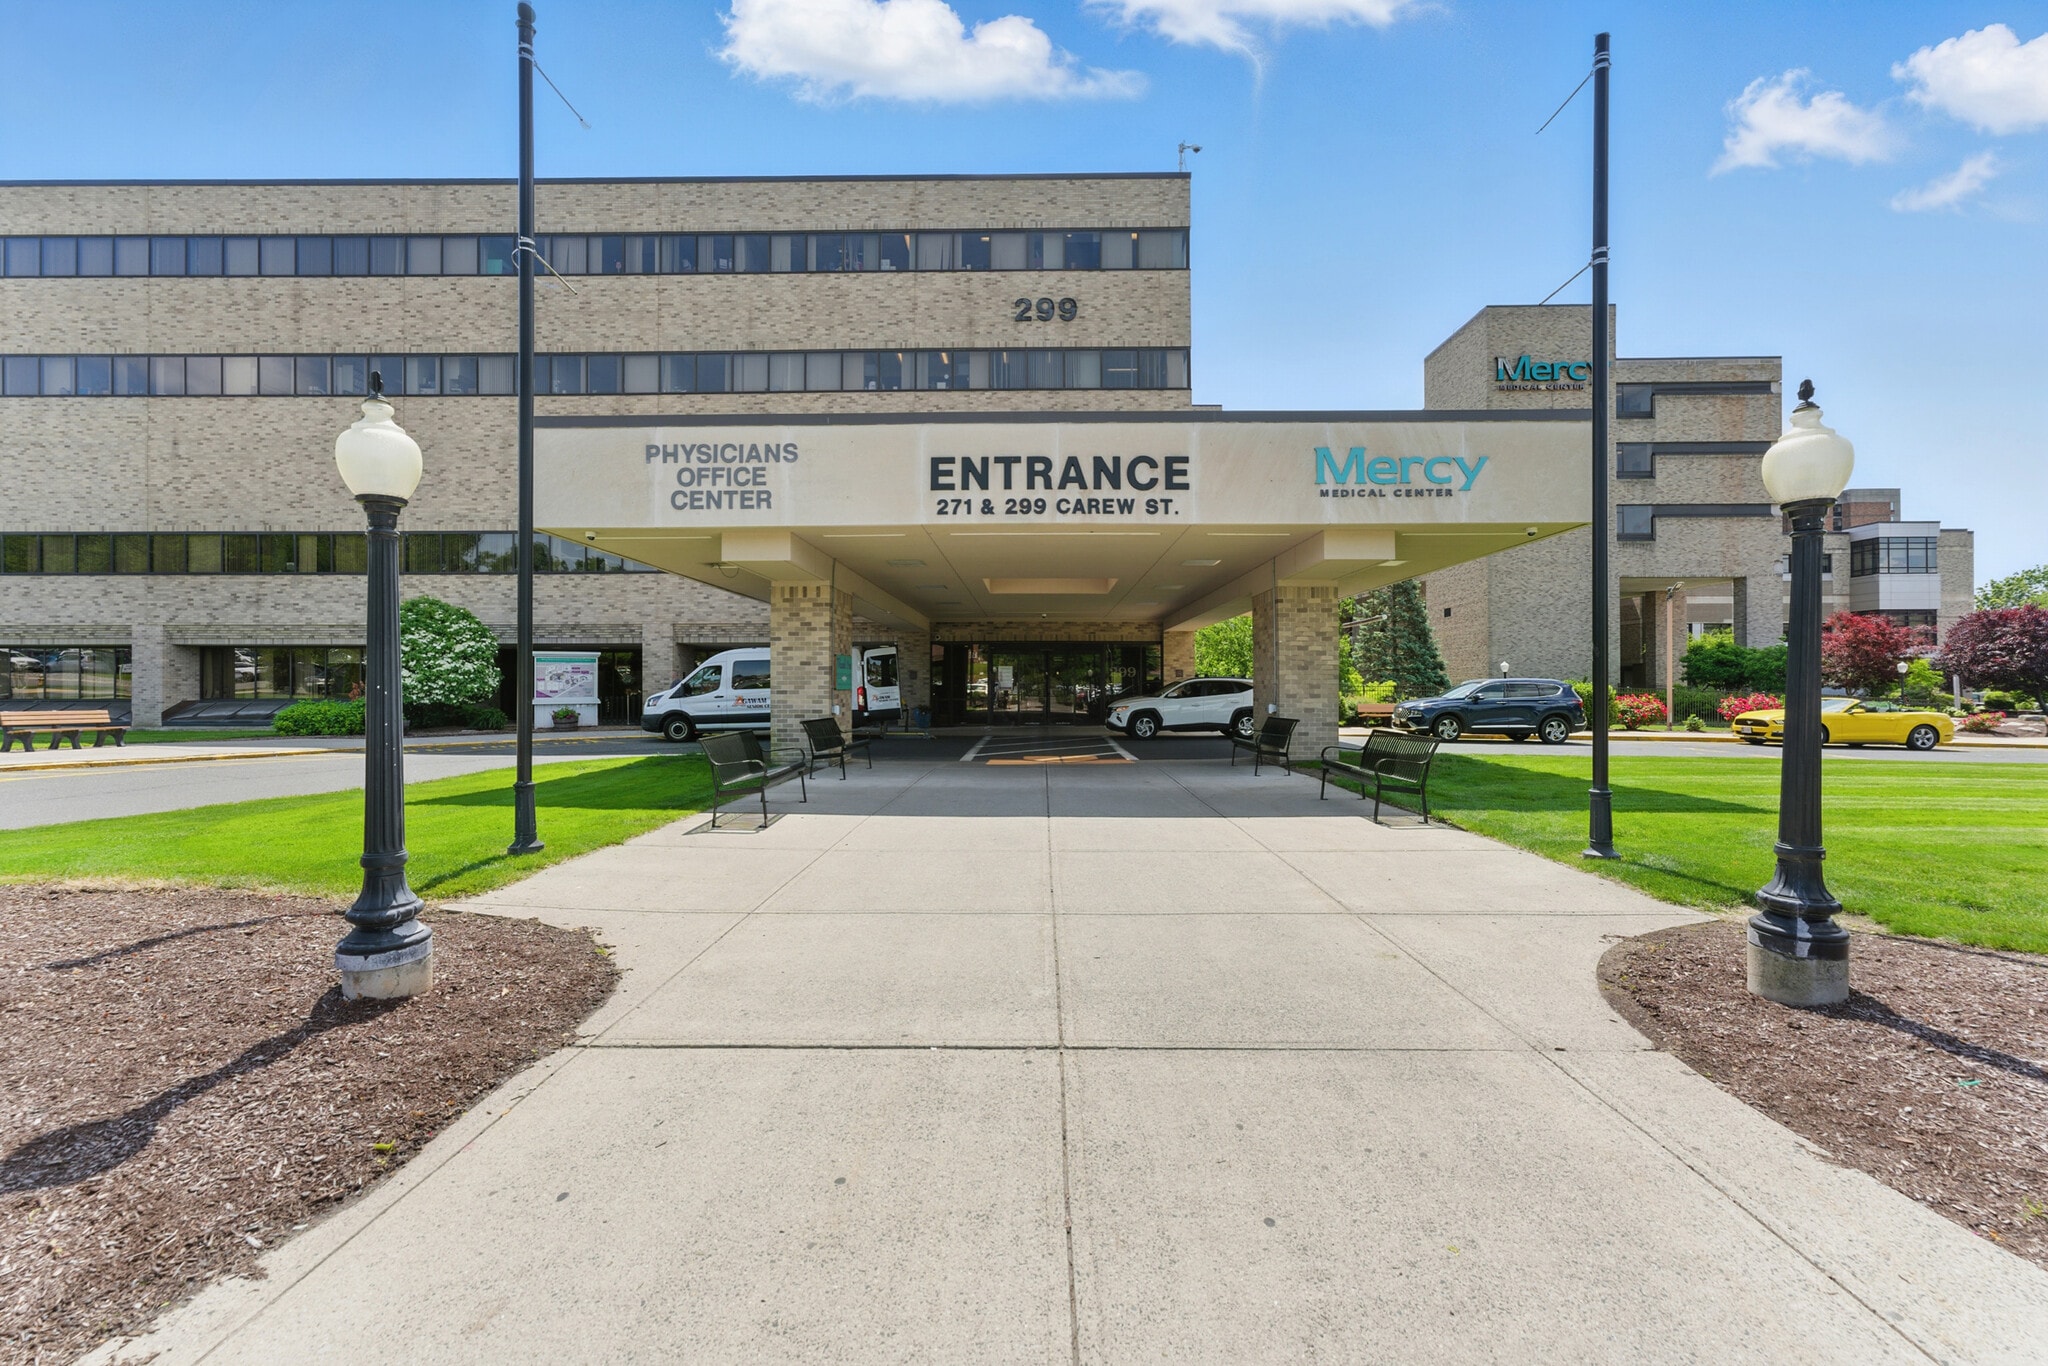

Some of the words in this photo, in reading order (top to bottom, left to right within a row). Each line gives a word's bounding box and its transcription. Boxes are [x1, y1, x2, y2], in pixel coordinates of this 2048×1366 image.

[1015, 297, 1077, 322] 299
[1499, 383, 1541, 391] MEDICAL
[645, 443, 799, 464] PHYSICIANS
[676, 466, 767, 487] OFFICE
[930, 455, 1190, 491] ENTRANCE
[1314, 446, 1489, 491] Mercy
[670, 490, 772, 511] CENTER
[1319, 488, 1386, 498] MEDICAL
[1393, 488, 1453, 498] CENTER
[936, 499, 972, 515] 271
[980, 498, 995, 515] &
[1005, 498, 1047, 515] 299
[1056, 498, 1135, 515] CAREW
[1145, 498, 1179, 515] ST.
